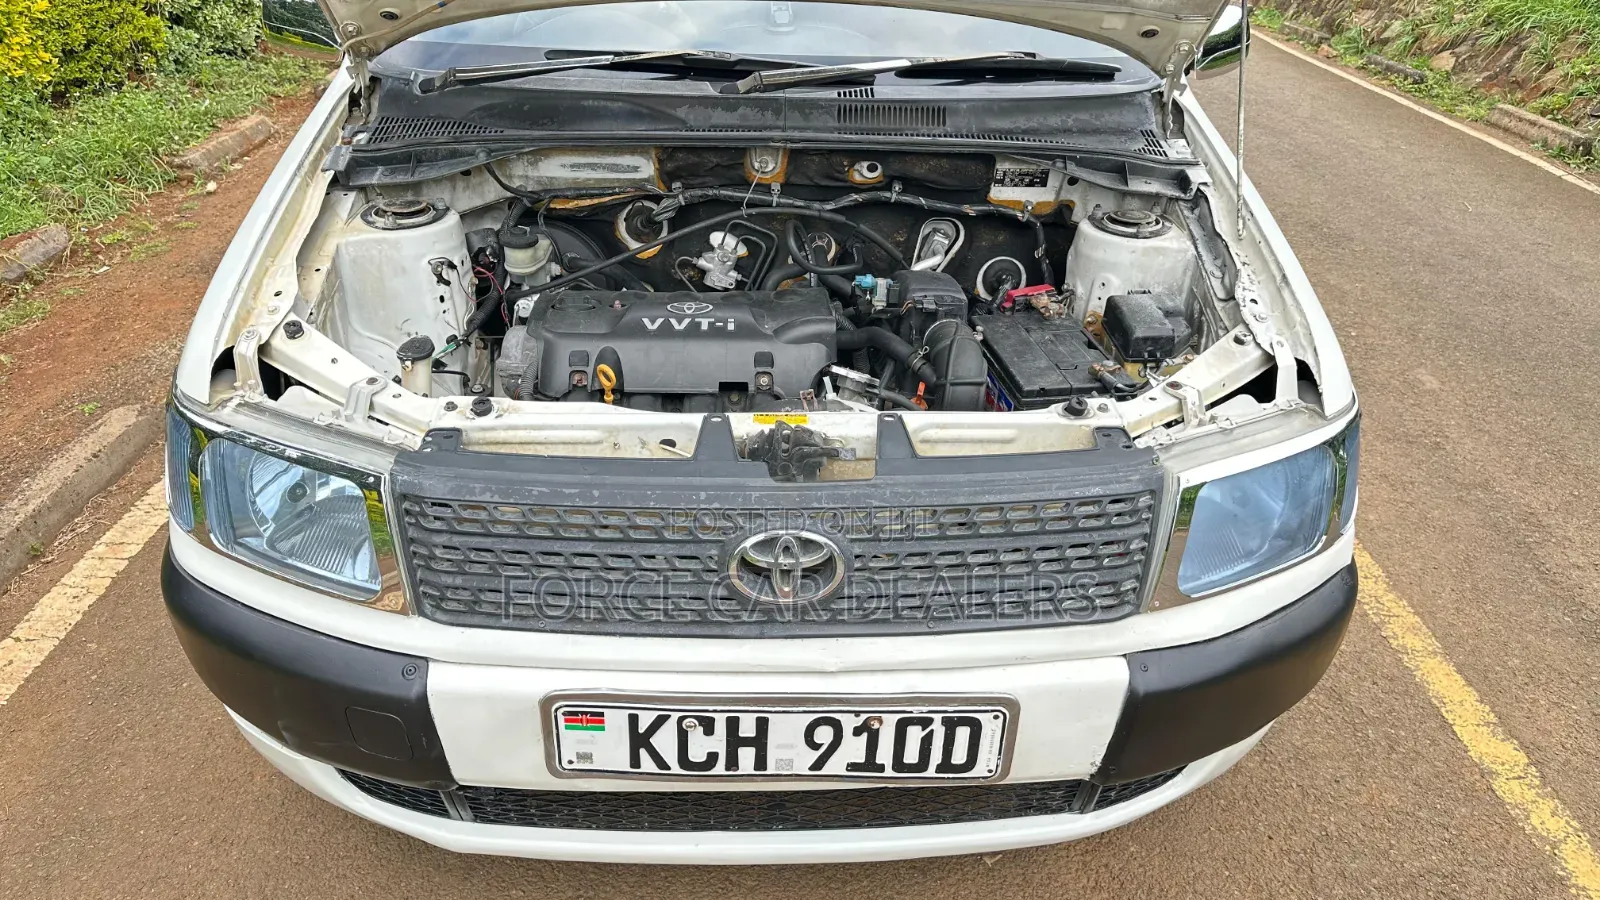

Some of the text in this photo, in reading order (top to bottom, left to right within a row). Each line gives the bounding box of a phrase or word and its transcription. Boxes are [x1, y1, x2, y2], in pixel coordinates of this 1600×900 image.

[641, 317, 735, 331] VVT-i
[627, 712, 770, 772] KCH
[803, 715, 983, 774] 910D
